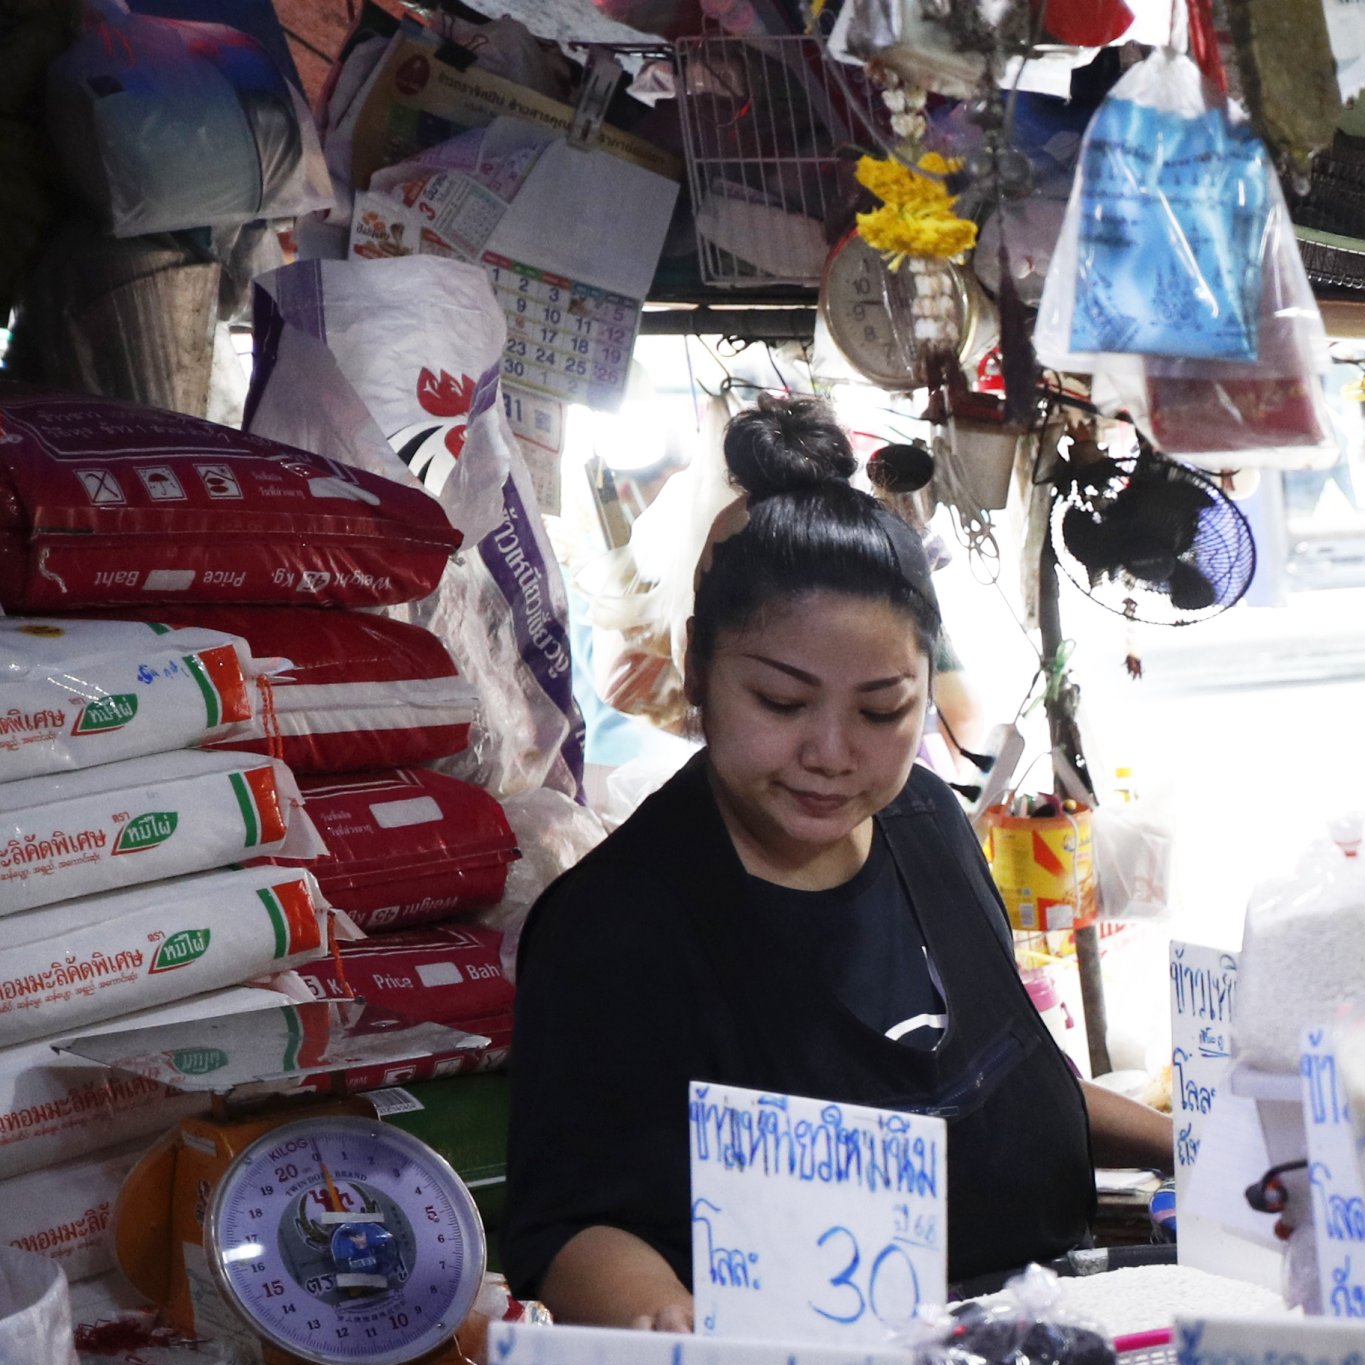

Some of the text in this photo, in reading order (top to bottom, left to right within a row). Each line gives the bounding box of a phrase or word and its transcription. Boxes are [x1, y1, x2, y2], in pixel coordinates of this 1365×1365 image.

[519, 278, 530, 292] 2
[548, 288, 560, 302] 3
[852, 277, 871, 297] 10
[516, 297, 625, 345] 9 10 11 12
[541, 328, 622, 364] 17 18 19
[506, 338, 526, 356] 23
[535, 348, 556, 366] 24
[565, 357, 587, 375] 25
[504, 359, 525, 377] 30
[94, 569, 141, 588] Baht
[203, 570, 247, 589] Price
[271, 568, 296, 590] Kg.
[333, 567, 393, 593] Weight
[111, 811, 131, 824] ตรา
[127, 815, 173, 843] หมีไผ่
[147, 930, 166, 943] ตรา
[163, 931, 206, 961] หมีไผ่
[465, 962, 501, 981] Bah
[274, 1162, 299, 1184] 20
[259, 1185, 275, 1197] 19
[414, 1185, 423, 1196] 4
[248, 1207, 264, 1219] 18
[424, 1204, 438, 1223] 5
[436, 1233, 446, 1245] 6
[250, 1261, 266, 1274] 16
[438, 1260, 448, 1271] 7
[807, 1225, 921, 1324] 30
[261, 1279, 285, 1299] 15
[282, 1303, 297, 1315] 14
[306, 1319, 322, 1331] 13
[388, 1312, 410, 1331] 10
[335, 1326, 350, 1339] 12
[364, 1326, 378, 1339] 11
